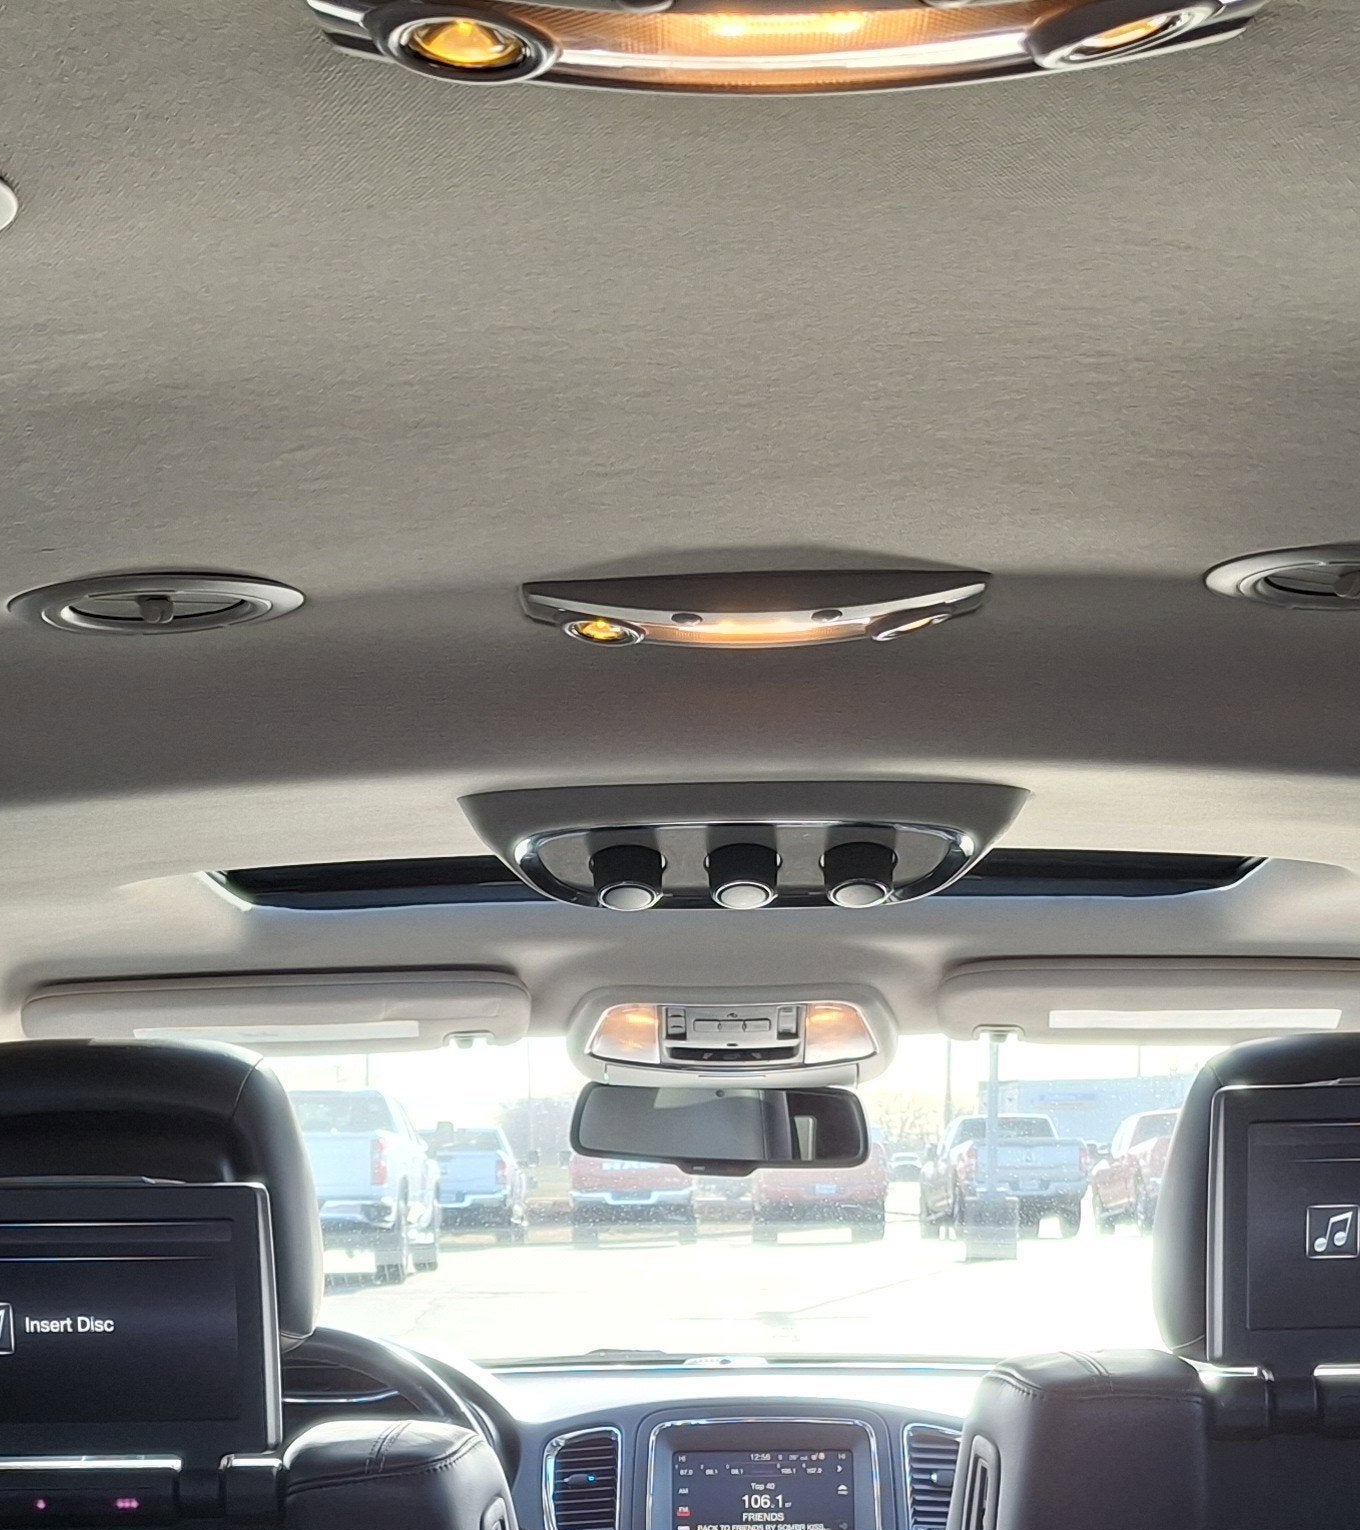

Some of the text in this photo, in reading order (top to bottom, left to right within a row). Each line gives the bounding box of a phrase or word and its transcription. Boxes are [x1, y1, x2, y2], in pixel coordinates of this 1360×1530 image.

[25, 1316, 115, 1333] Insert Disc
[741, 1494, 783, 1509] 106.1
[742, 1512, 785, 1522] FRIENDS
